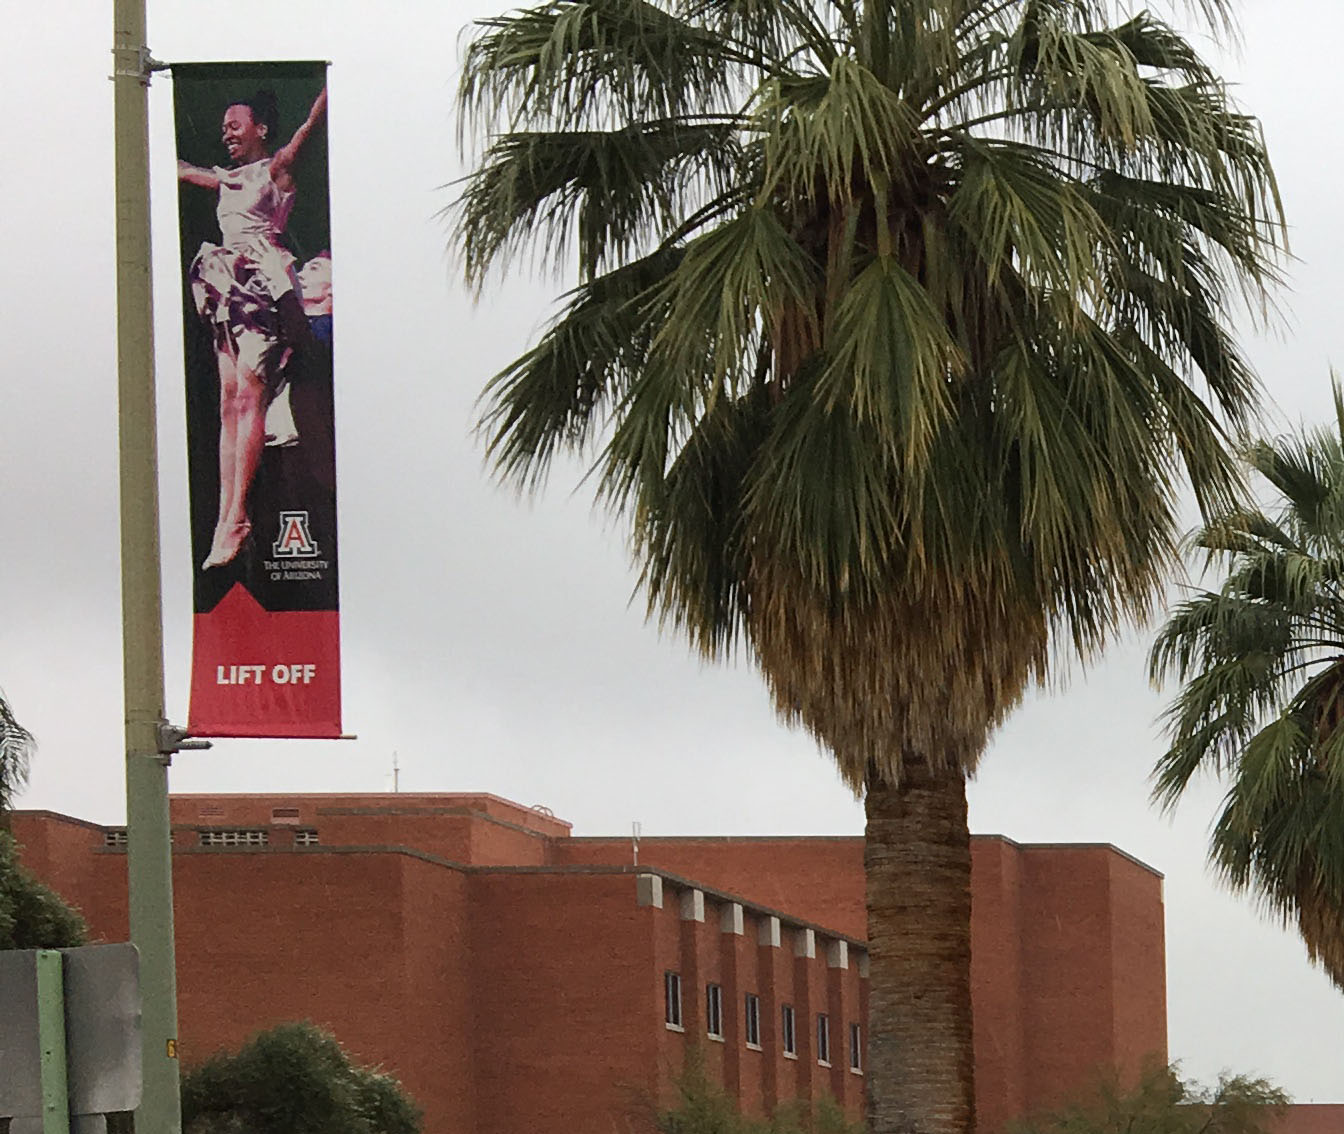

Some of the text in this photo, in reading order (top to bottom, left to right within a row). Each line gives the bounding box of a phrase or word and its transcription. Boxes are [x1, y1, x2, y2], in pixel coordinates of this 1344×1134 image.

[264, 561, 328, 570] THE UNIVERSITY
[270, 571, 321, 580] OF ARIZONA
[217, 664, 316, 684] LIFT OFF
